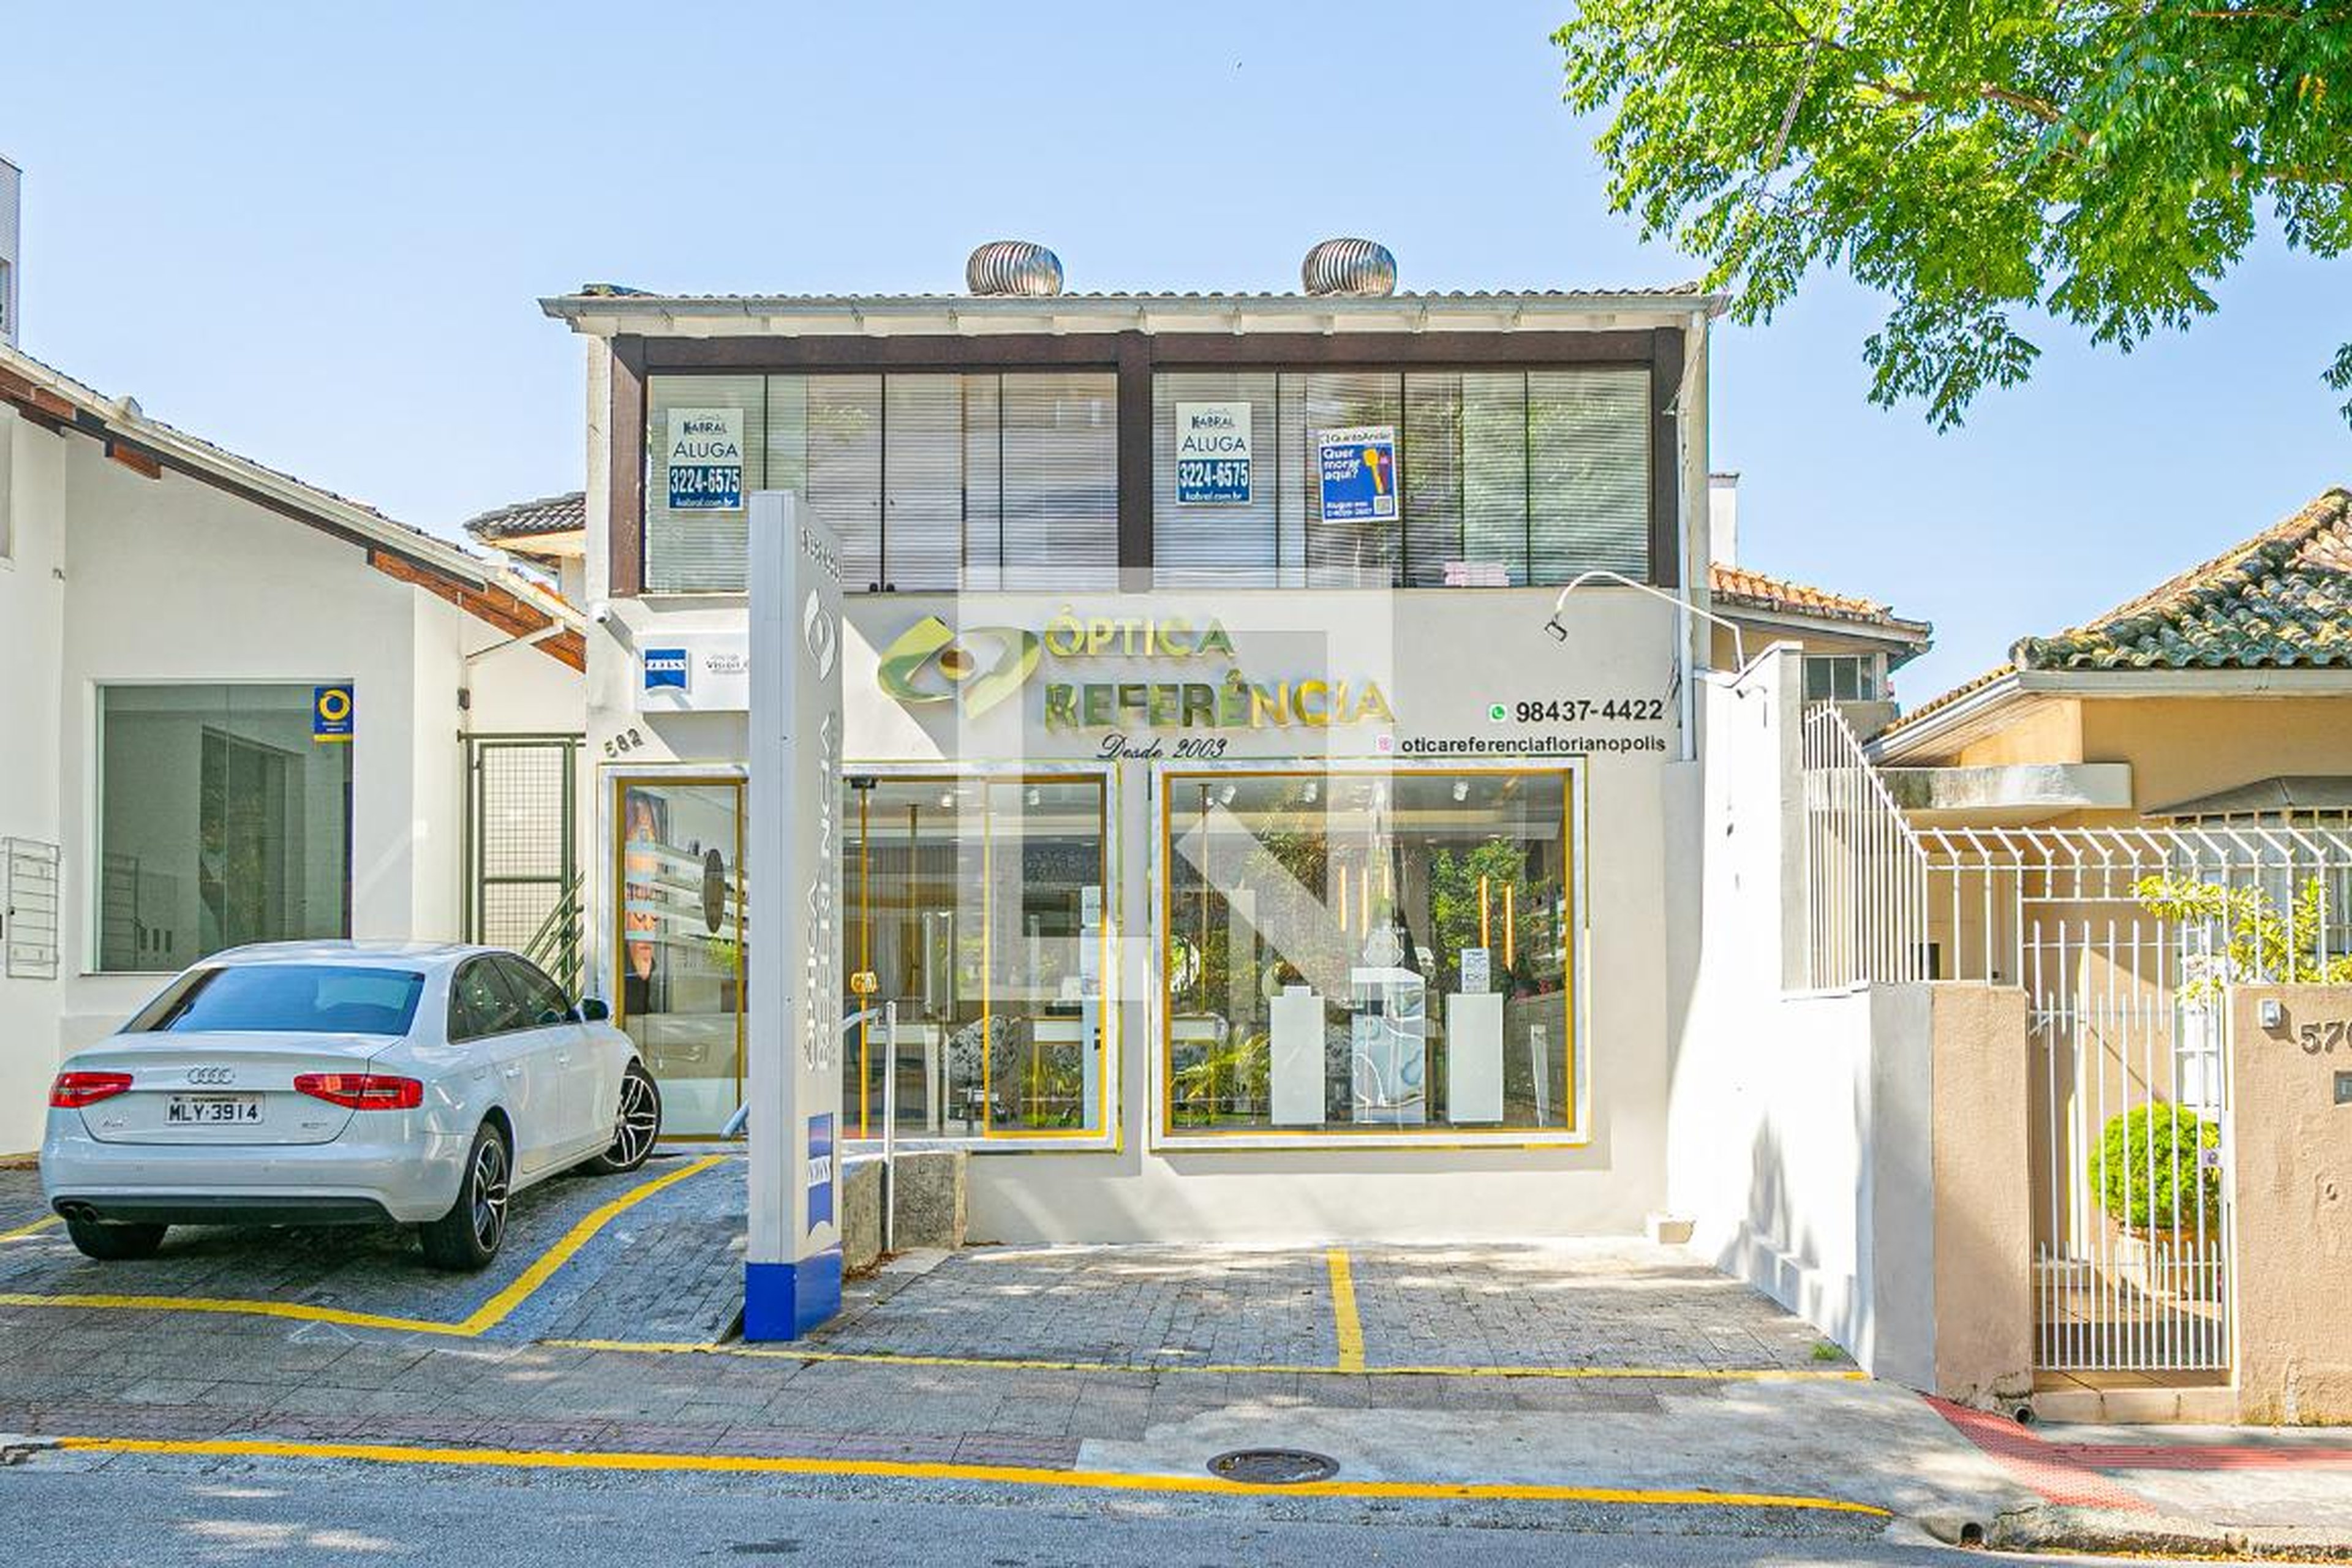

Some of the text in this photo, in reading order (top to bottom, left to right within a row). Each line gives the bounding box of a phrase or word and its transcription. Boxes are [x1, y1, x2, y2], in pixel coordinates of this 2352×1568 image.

[674, 441, 737, 458] ALUGA
[1182, 435, 1246, 451] ALUGA
[1323, 448, 1354, 459] Quer
[671, 469, 739, 493] 3224-6575
[1180, 462, 1248, 487] 3224-6575
[1324, 468, 1359, 482] aqui?
[1045, 604, 1235, 656] ÓPTICA
[1045, 669, 1395, 729] REFERÊNCIA
[1516, 699, 1663, 723] 98437-4422
[1096, 734, 1228, 760] Desde 2003
[1401, 736, 1667, 753] oticareferenciaflorianopolis
[2301, 1021, 2352, 1055] 57
